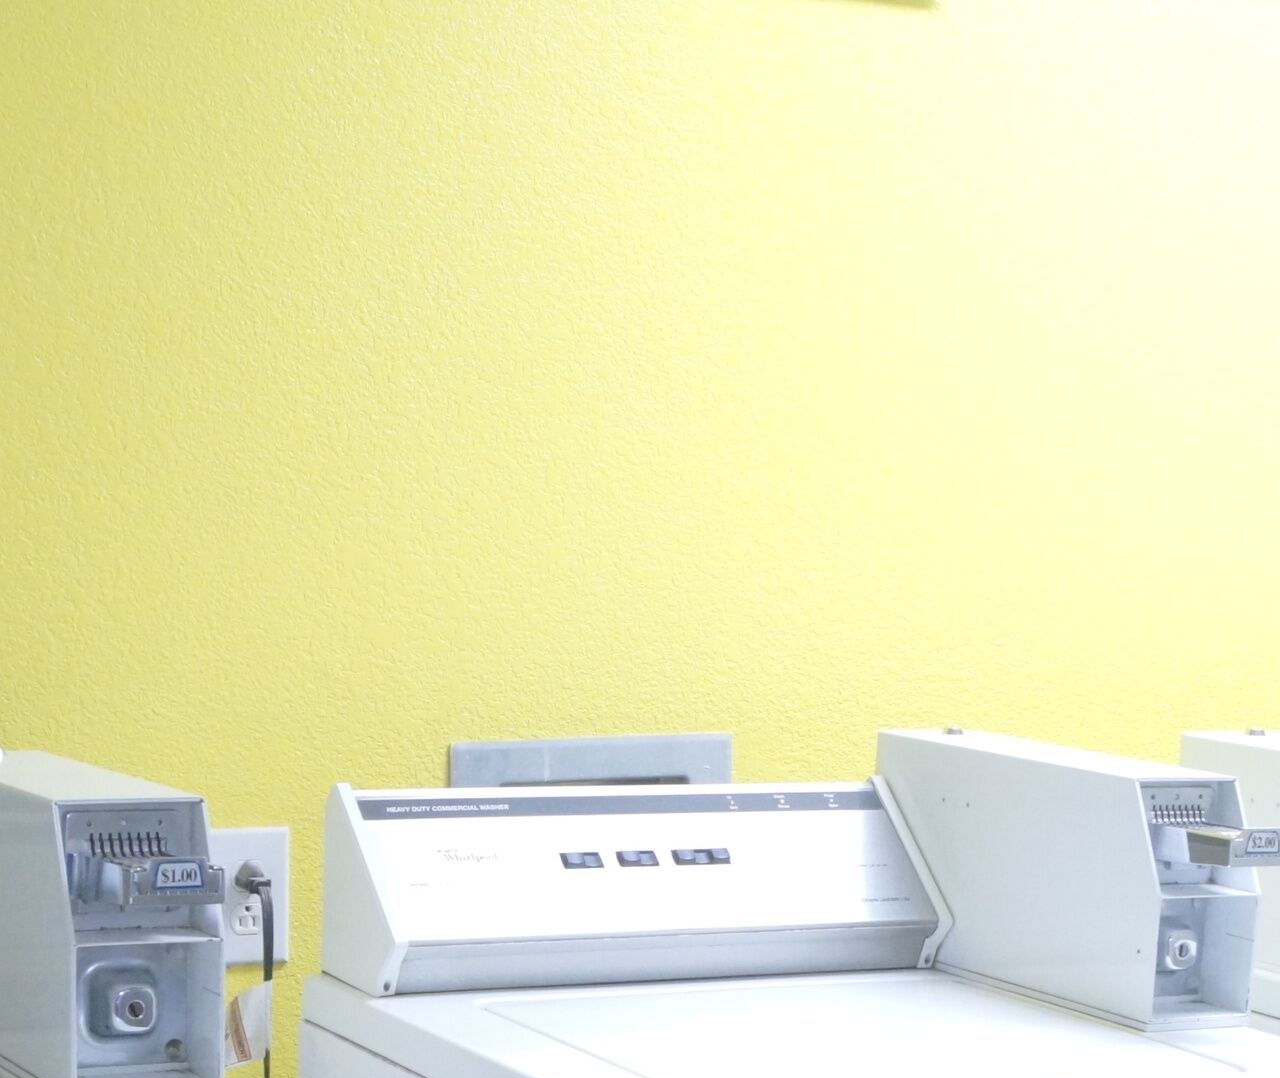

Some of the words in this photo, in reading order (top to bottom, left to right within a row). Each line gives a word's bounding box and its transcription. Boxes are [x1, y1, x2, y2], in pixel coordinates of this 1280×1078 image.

[431, 804, 479, 812] COMMERCIAL
[1252, 835, 1276, 848] $2.00
[161, 868, 197, 883] $1.00
